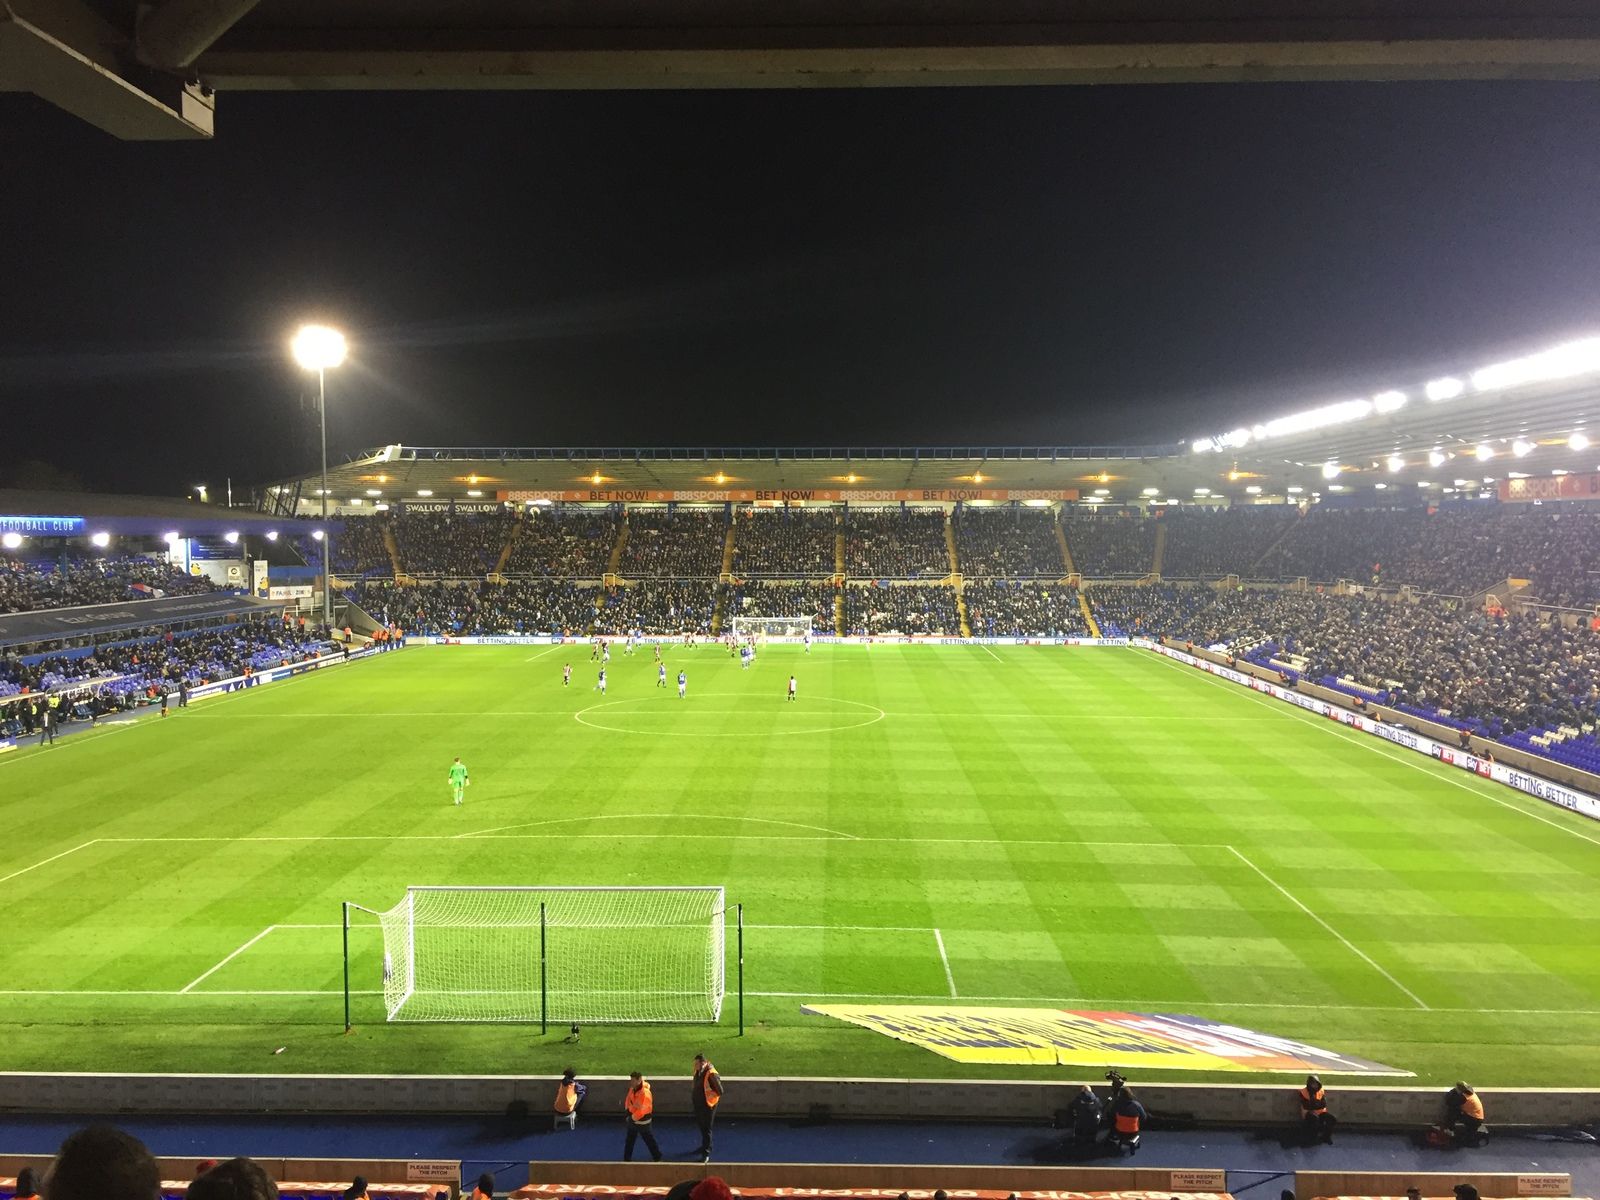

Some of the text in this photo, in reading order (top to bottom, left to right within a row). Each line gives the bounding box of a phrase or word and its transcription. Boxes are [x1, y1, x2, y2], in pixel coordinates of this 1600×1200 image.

[508, 491, 564, 500] 888SPORT
[590, 491, 649, 500] BET NOW!
[673, 491, 730, 500] 888SPORT
[756, 491, 814, 500] BET NOW!
[840, 490, 896, 500] 888SPORT
[923, 490, 981, 500] BET NOW!
[1008, 490, 1065, 500] 888SPORT
[406, 504, 450, 512] SWALLOW
[455, 504, 498, 512] SWALLOW
[3, 520, 74, 531] FOOTBALL CLUB
[1545, 786, 1578, 808] BETTER
